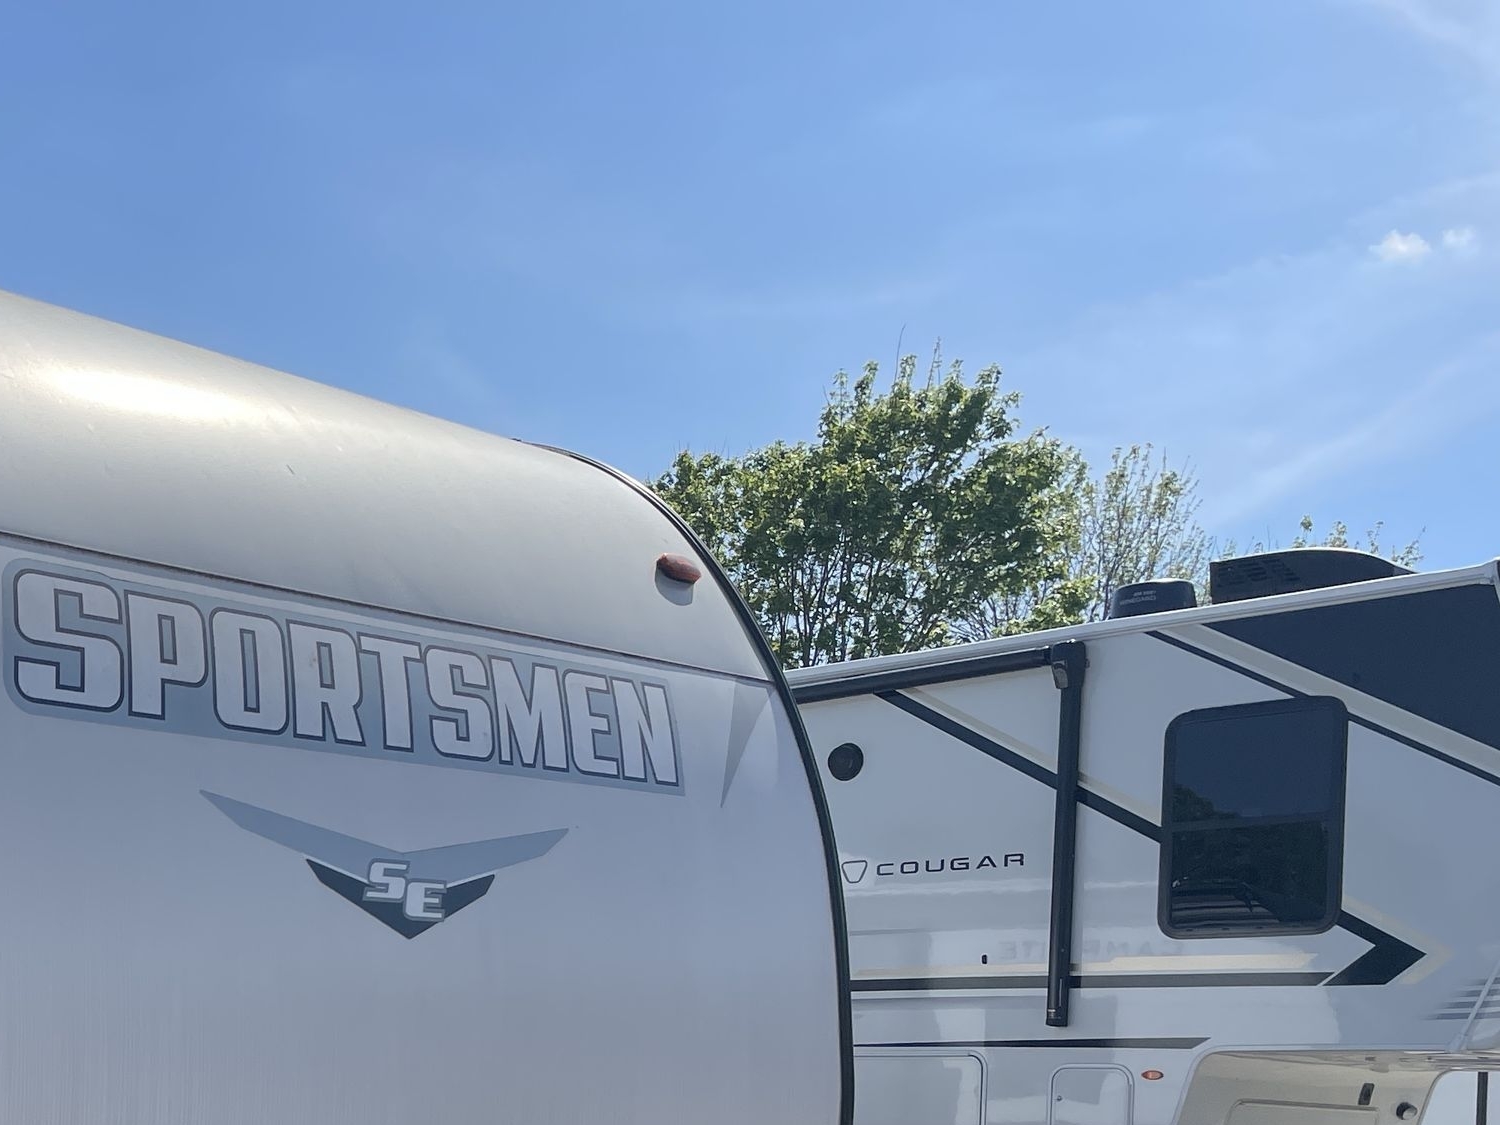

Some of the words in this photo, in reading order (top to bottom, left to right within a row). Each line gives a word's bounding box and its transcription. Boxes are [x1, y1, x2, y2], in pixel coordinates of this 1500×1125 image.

[13, 568, 681, 787] SPORTSMEN
[363, 858, 447, 921] SE
[876, 853, 1025, 876] COUGAR
